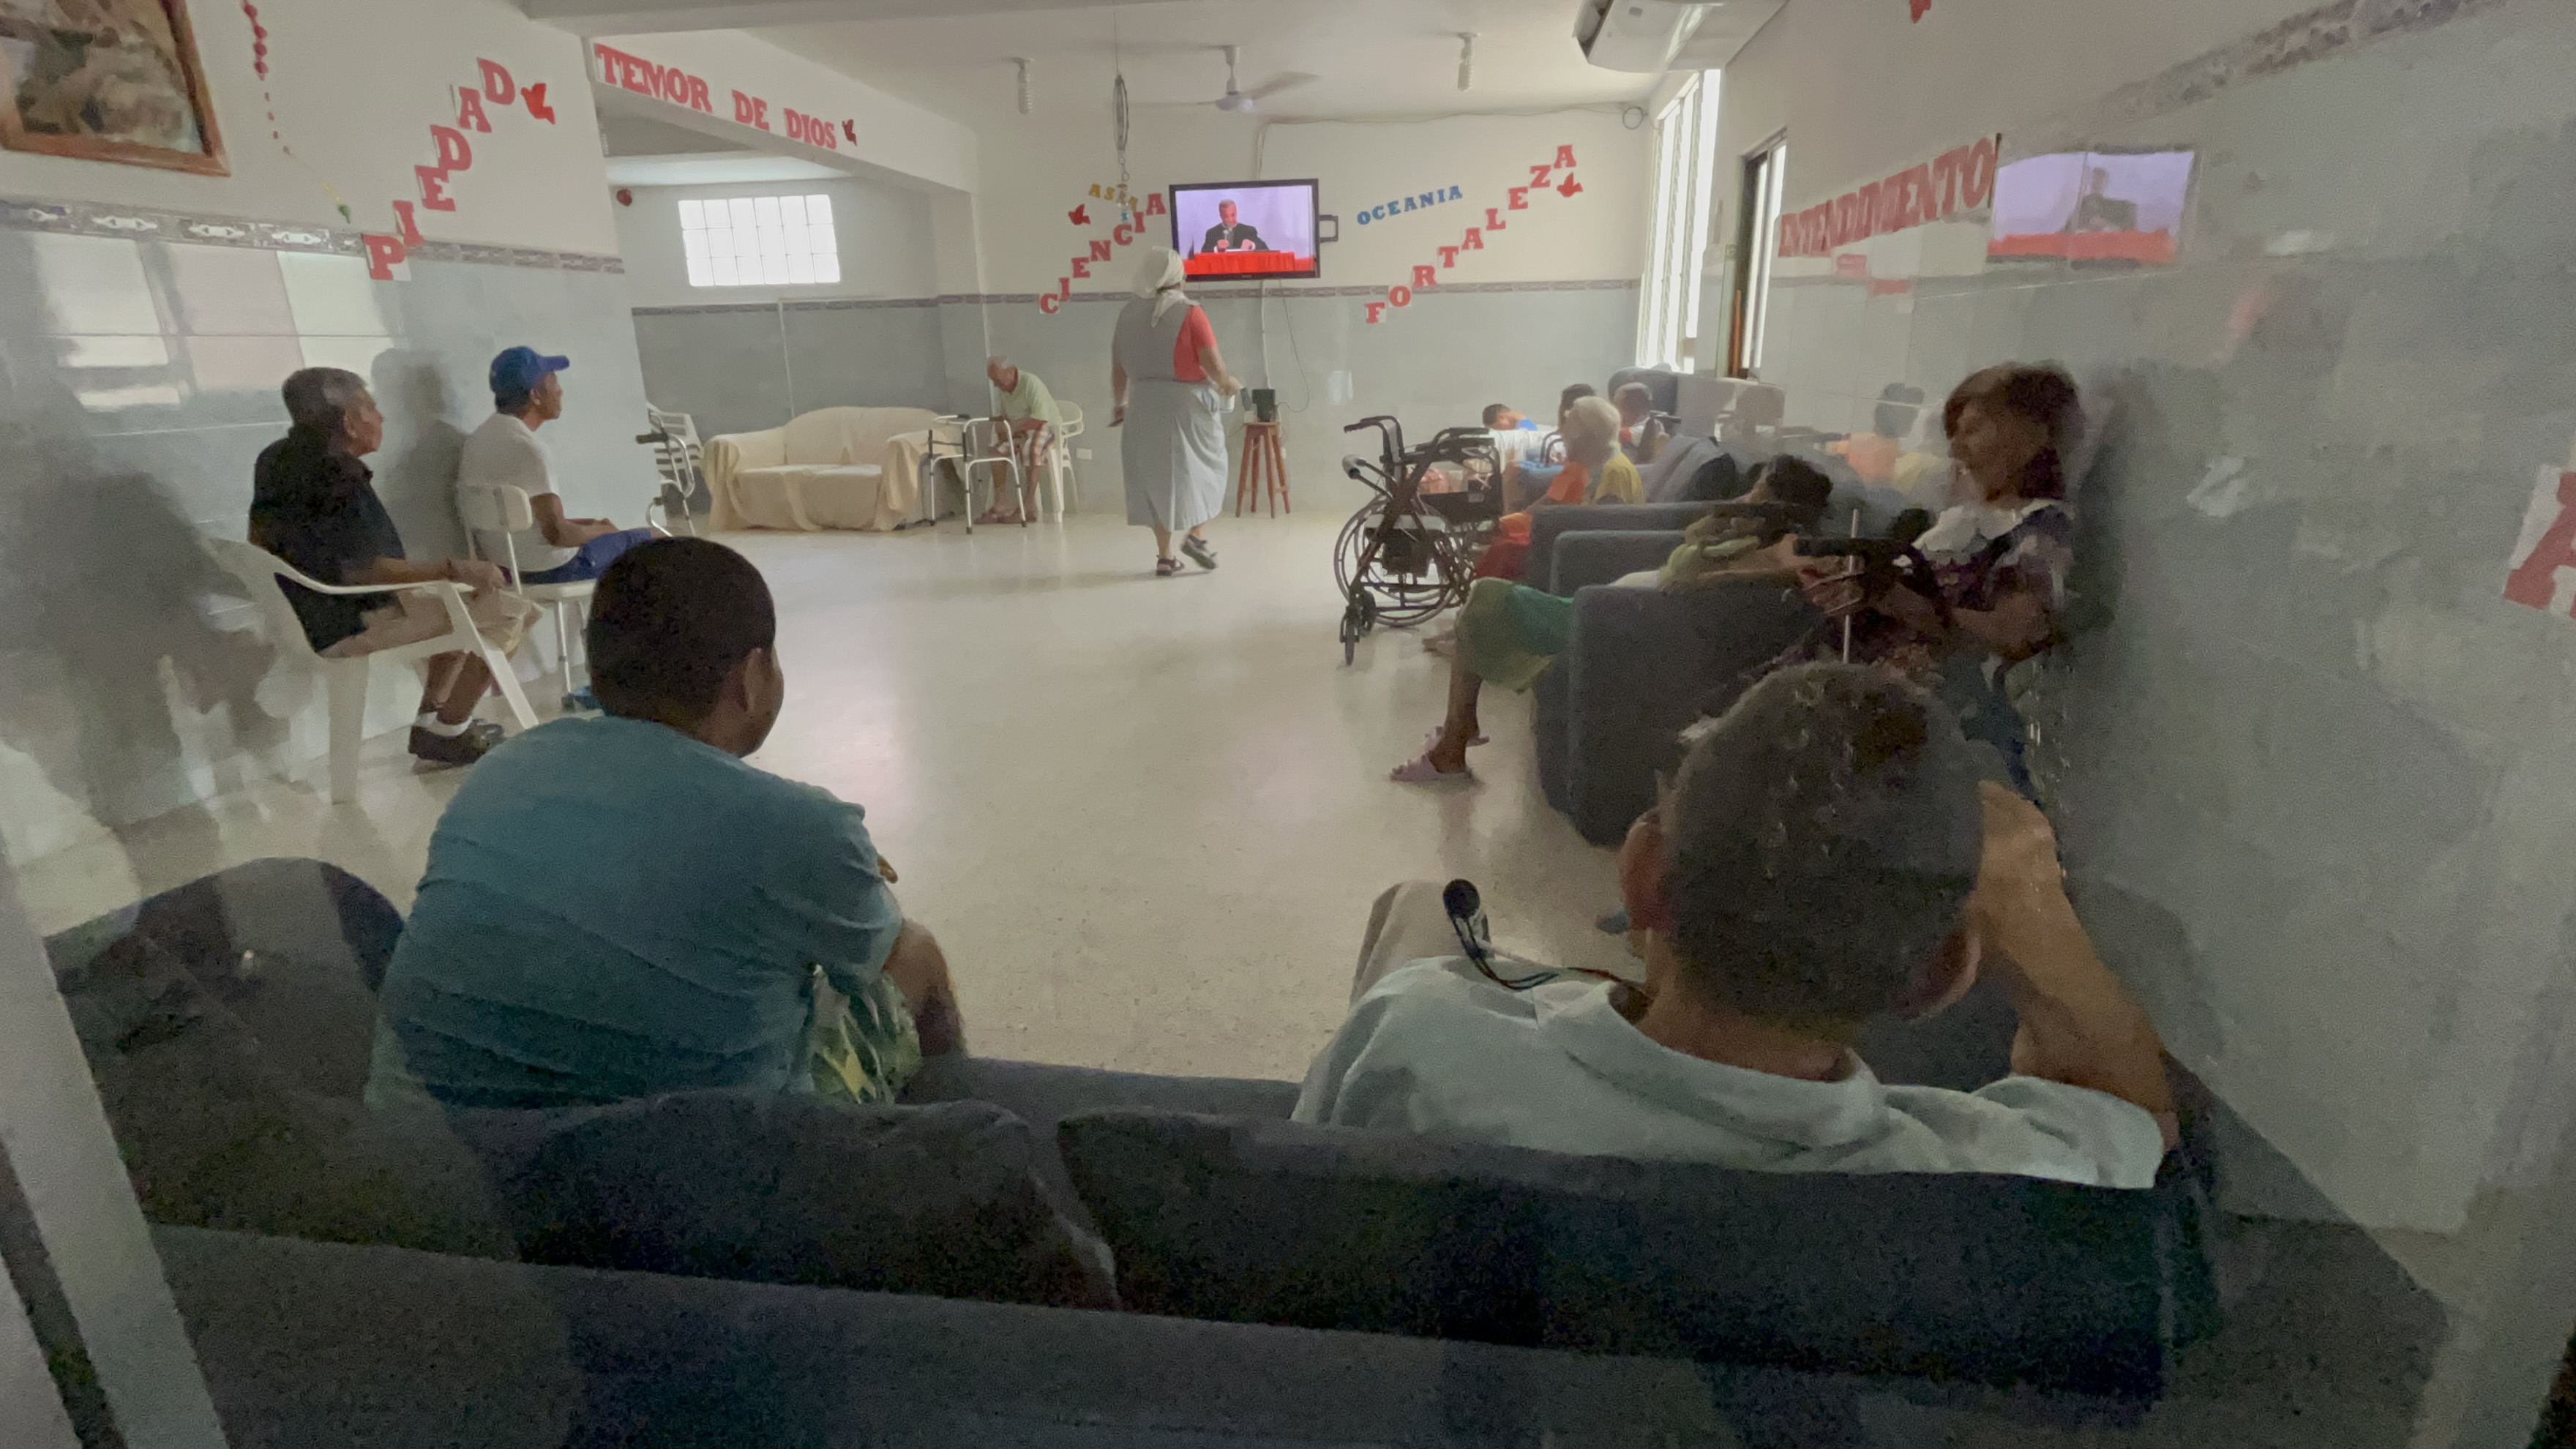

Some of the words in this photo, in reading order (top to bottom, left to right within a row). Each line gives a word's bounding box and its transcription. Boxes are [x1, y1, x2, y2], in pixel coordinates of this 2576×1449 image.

[594, 42, 712, 113] TEMOR
[732, 89, 769, 130] DE
[783, 108, 836, 149] DIOS
[362, 57, 516, 280] PIEDAD
[1357, 185, 1463, 225] OCEANIA
[1040, 193, 1166, 314] CIENCIA
[1364, 144, 1577, 324] FORTALEZA
